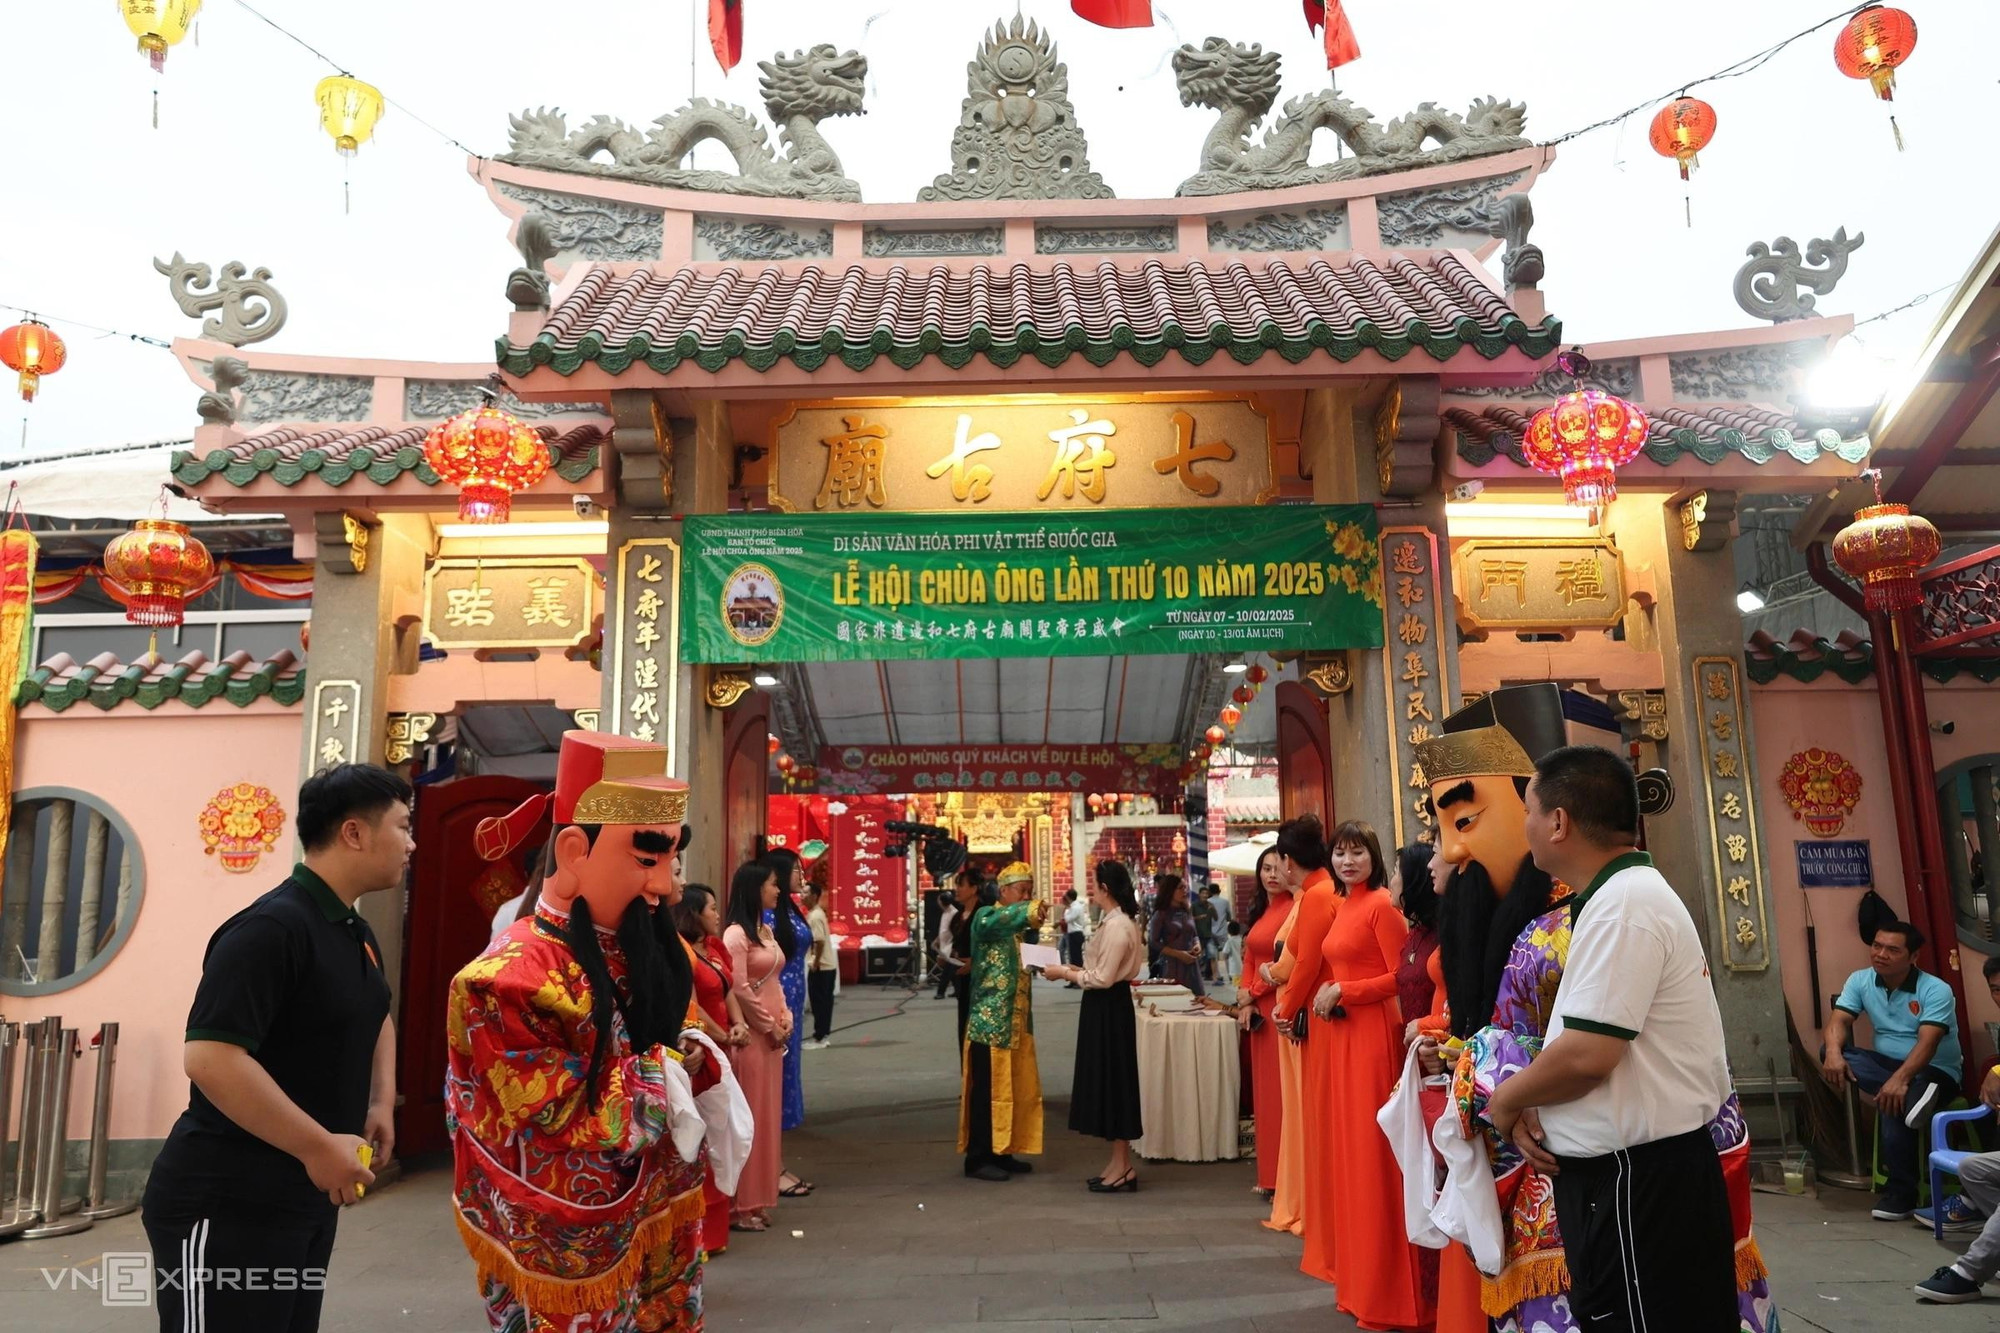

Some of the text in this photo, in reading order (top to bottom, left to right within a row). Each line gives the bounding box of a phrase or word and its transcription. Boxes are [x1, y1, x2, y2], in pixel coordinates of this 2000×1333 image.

[815, 408, 1236, 509] 七府古廟
[727, 538, 744, 546] BAN
[833, 526, 1117, 553] DI SẢN VĂN HÓA PHI VẬT THỂ QUỐC GIA
[785, 547, 803, 555] 2025
[833, 559, 861, 605] LỄ
[869, 563, 911, 612] HỘI
[920, 562, 987, 605] CHÙA
[994, 561, 1046, 603] ÔNG
[1053, 555, 1099, 601] LẦN
[1108, 558, 1156, 601] THỨ
[1162, 565, 1189, 600] 10
[1198, 558, 1256, 597] NĂM
[1264, 561, 1324, 596] 2025
[1166, 609, 1182, 623] TỪ
[1183, 608, 1212, 623] NGÀY
[1213, 611, 1226, 622] 07
[1236, 609, 1295, 622] 10/02/2025
[1178, 629, 1204, 641] (NGÀY
[1205, 630, 1216, 639] 10
[1223, 629, 1245, 639] 13/01
[1246, 627, 1261, 638] ÂM
[1262, 628, 1284, 640] LỊCH)
[320, 697, 349, 764] 千秋
[869, 749, 907, 767] CHÀO
[910, 749, 949, 765] MỪNG
[952, 748, 980, 764] QUÝ
[982, 747, 1028, 764] KHÁCH
[1051, 750, 1071, 767] DỰ
[1073, 745, 1088, 765] LỄ
[1091, 748, 1114, 769] HỘI
[1823, 847, 1846, 859] MUA
[1847, 844, 1866, 859] BÁN
